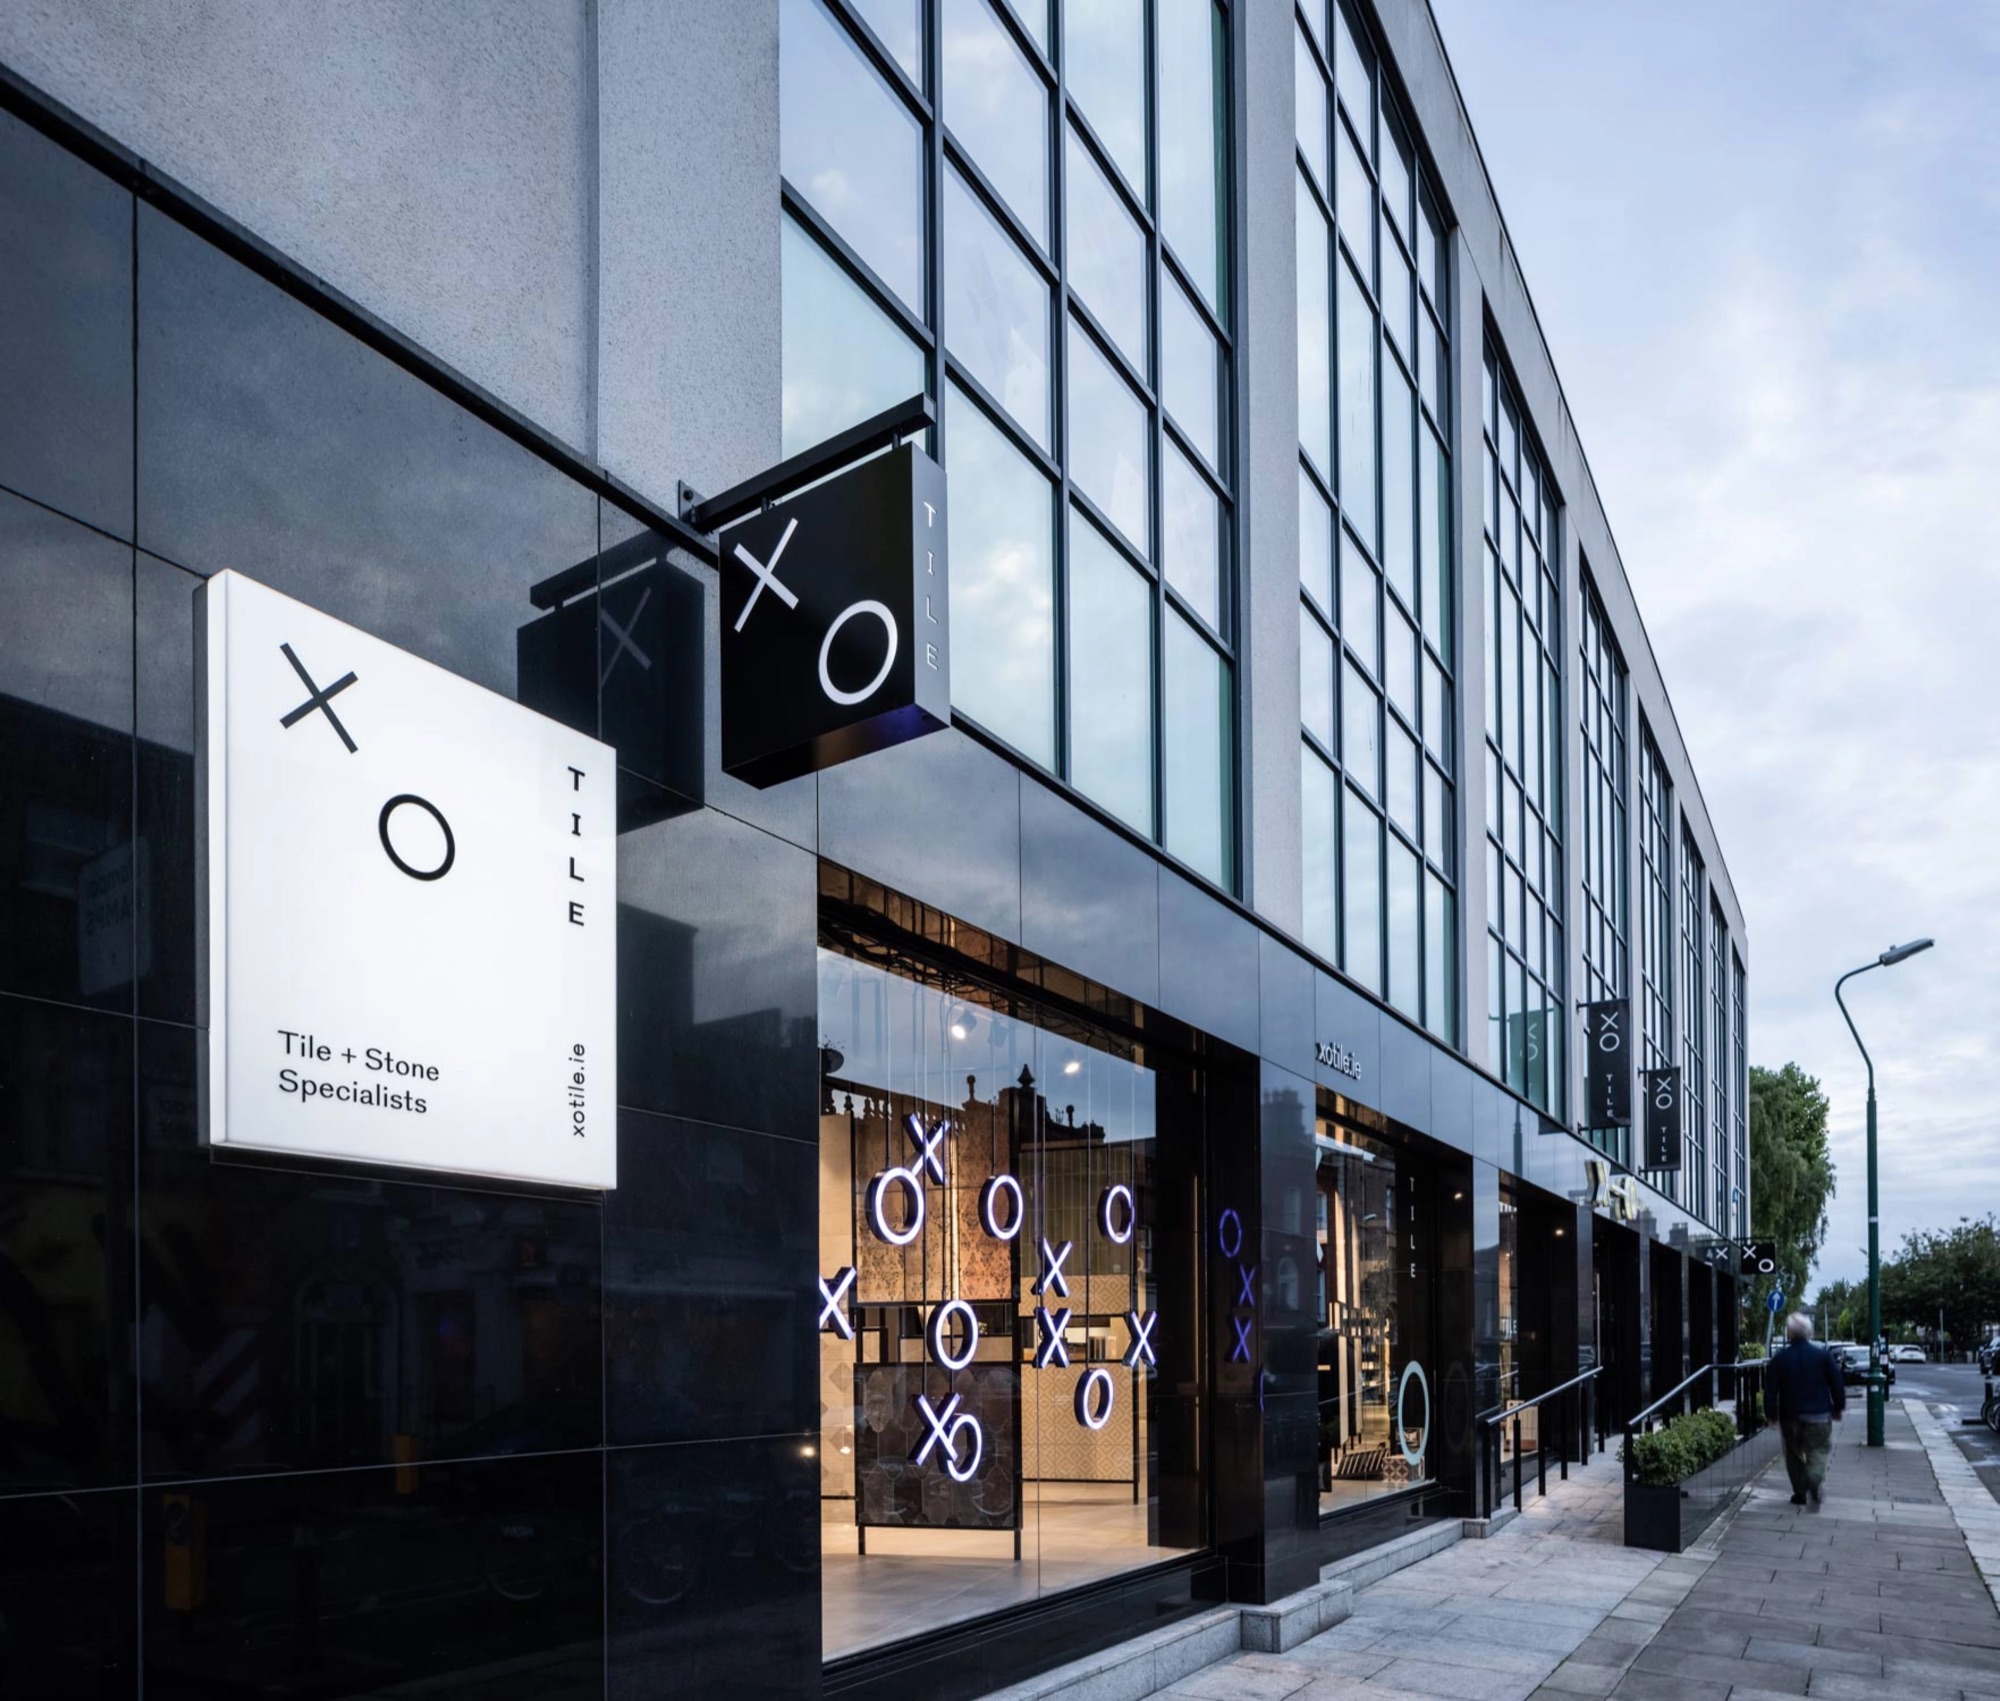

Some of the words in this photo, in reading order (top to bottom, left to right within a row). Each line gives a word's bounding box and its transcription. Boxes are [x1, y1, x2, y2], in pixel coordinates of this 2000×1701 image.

[923, 500, 938, 672] TILE
[567, 765, 586, 927] TILE
[277, 1030, 332, 1062] Tile
[364, 1047, 440, 1083] Stone
[277, 1069, 429, 1114] Specialists
[567, 1043, 586, 1138] xotile.ie
[1605, 1073, 1614, 1118] TILE
[1409, 1176, 1417, 1279] TILE
